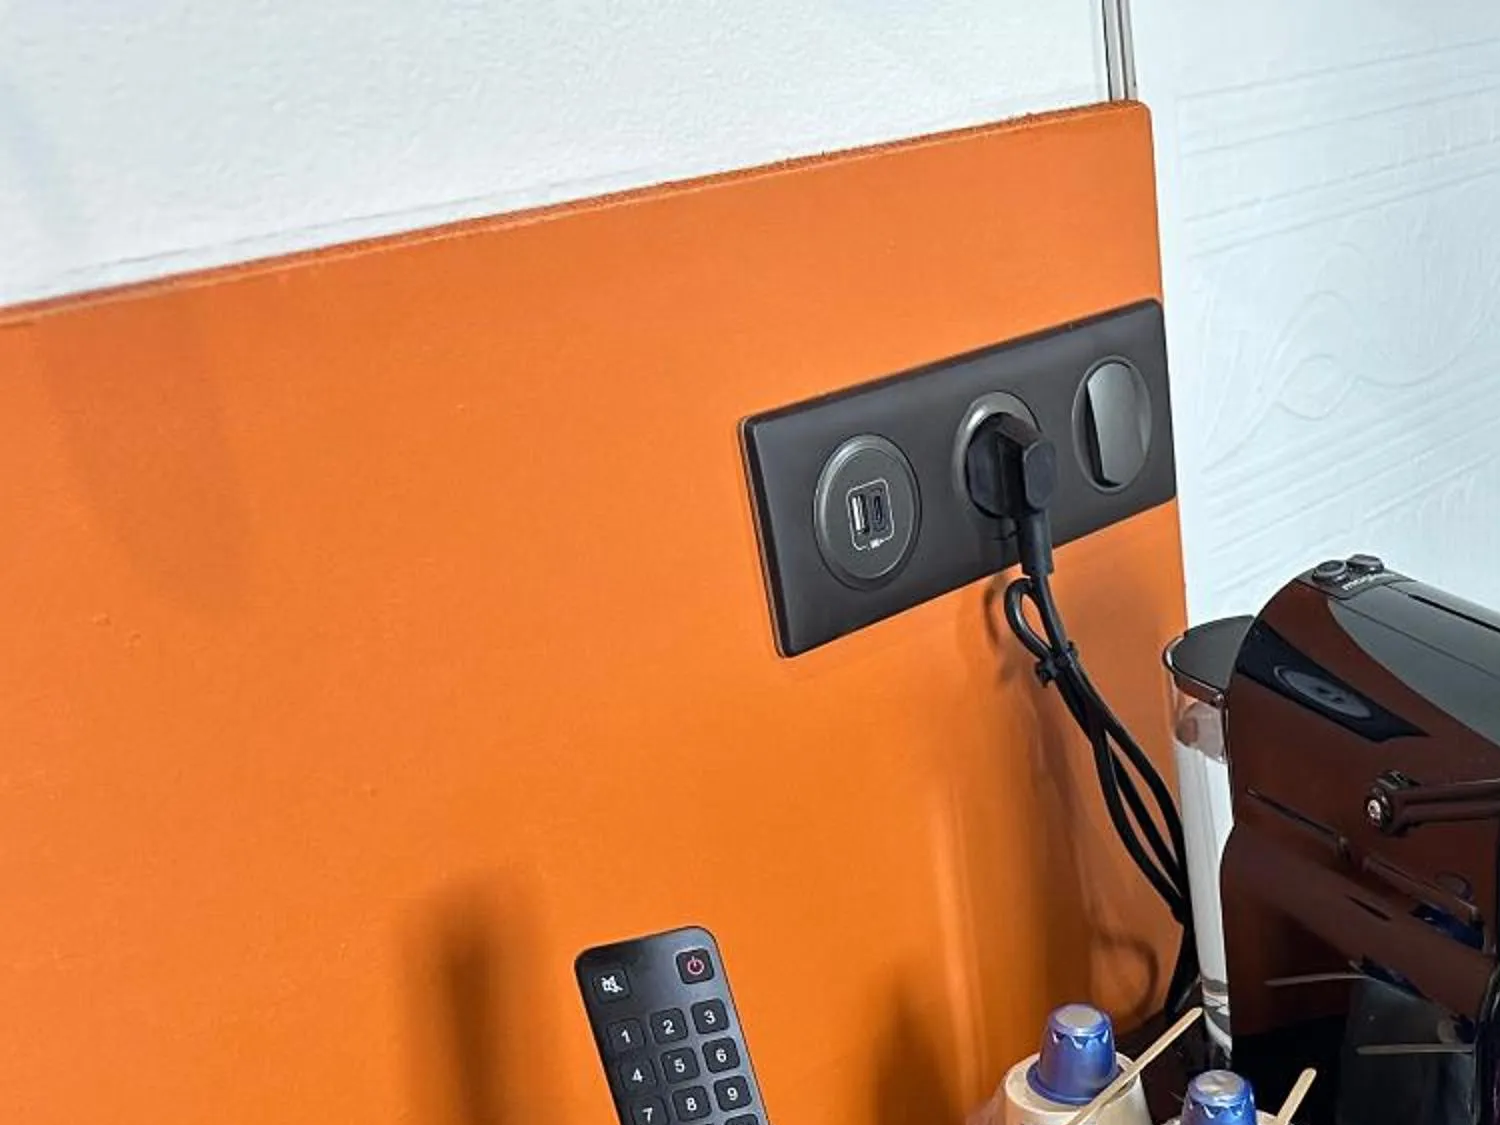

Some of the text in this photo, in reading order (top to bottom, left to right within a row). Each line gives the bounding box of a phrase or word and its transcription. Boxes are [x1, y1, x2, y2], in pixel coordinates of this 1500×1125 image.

[621, 1010, 716, 1044] 1 2 3
[631, 1048, 727, 1083] 4 5 6
[642, 1087, 739, 1123] 7 8 9
